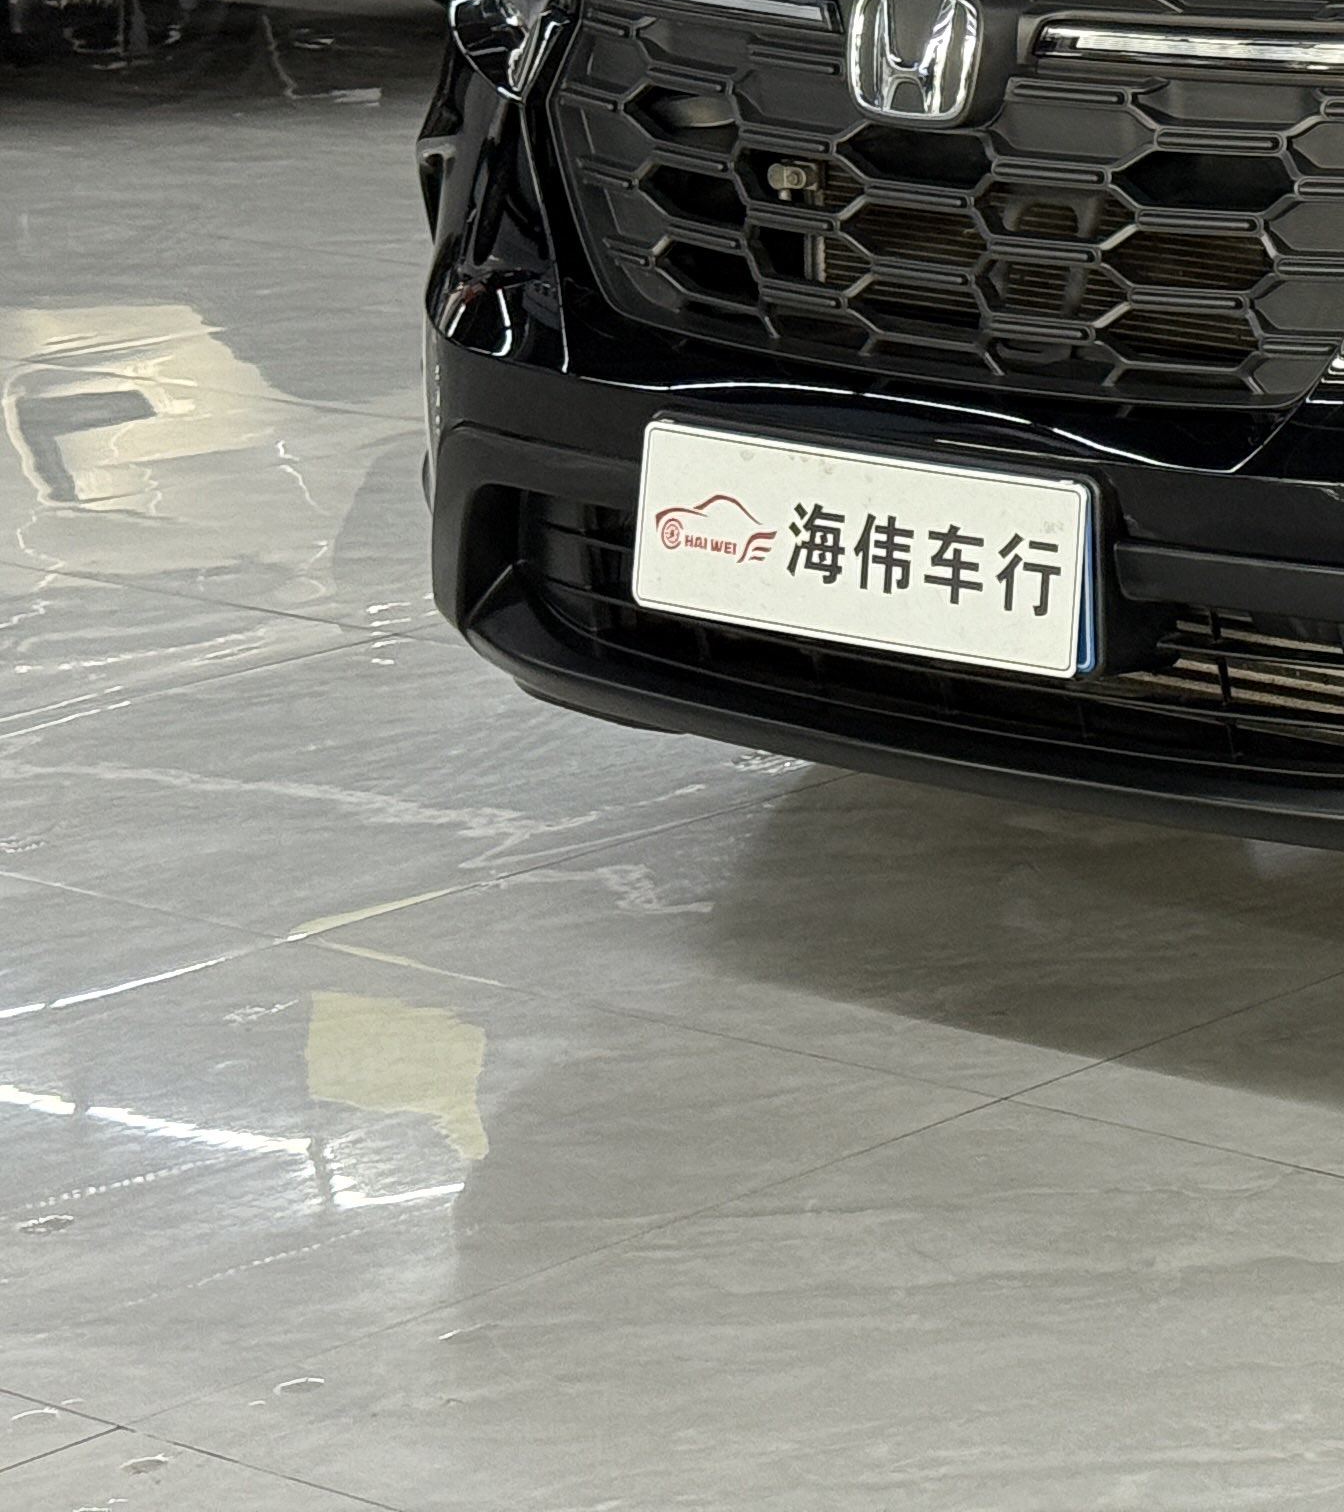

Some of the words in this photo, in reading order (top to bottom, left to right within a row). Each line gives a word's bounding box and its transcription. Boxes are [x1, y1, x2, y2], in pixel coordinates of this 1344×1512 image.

[710, 538, 737, 555] WEI
[786, 503, 1062, 617] 海伟车行
